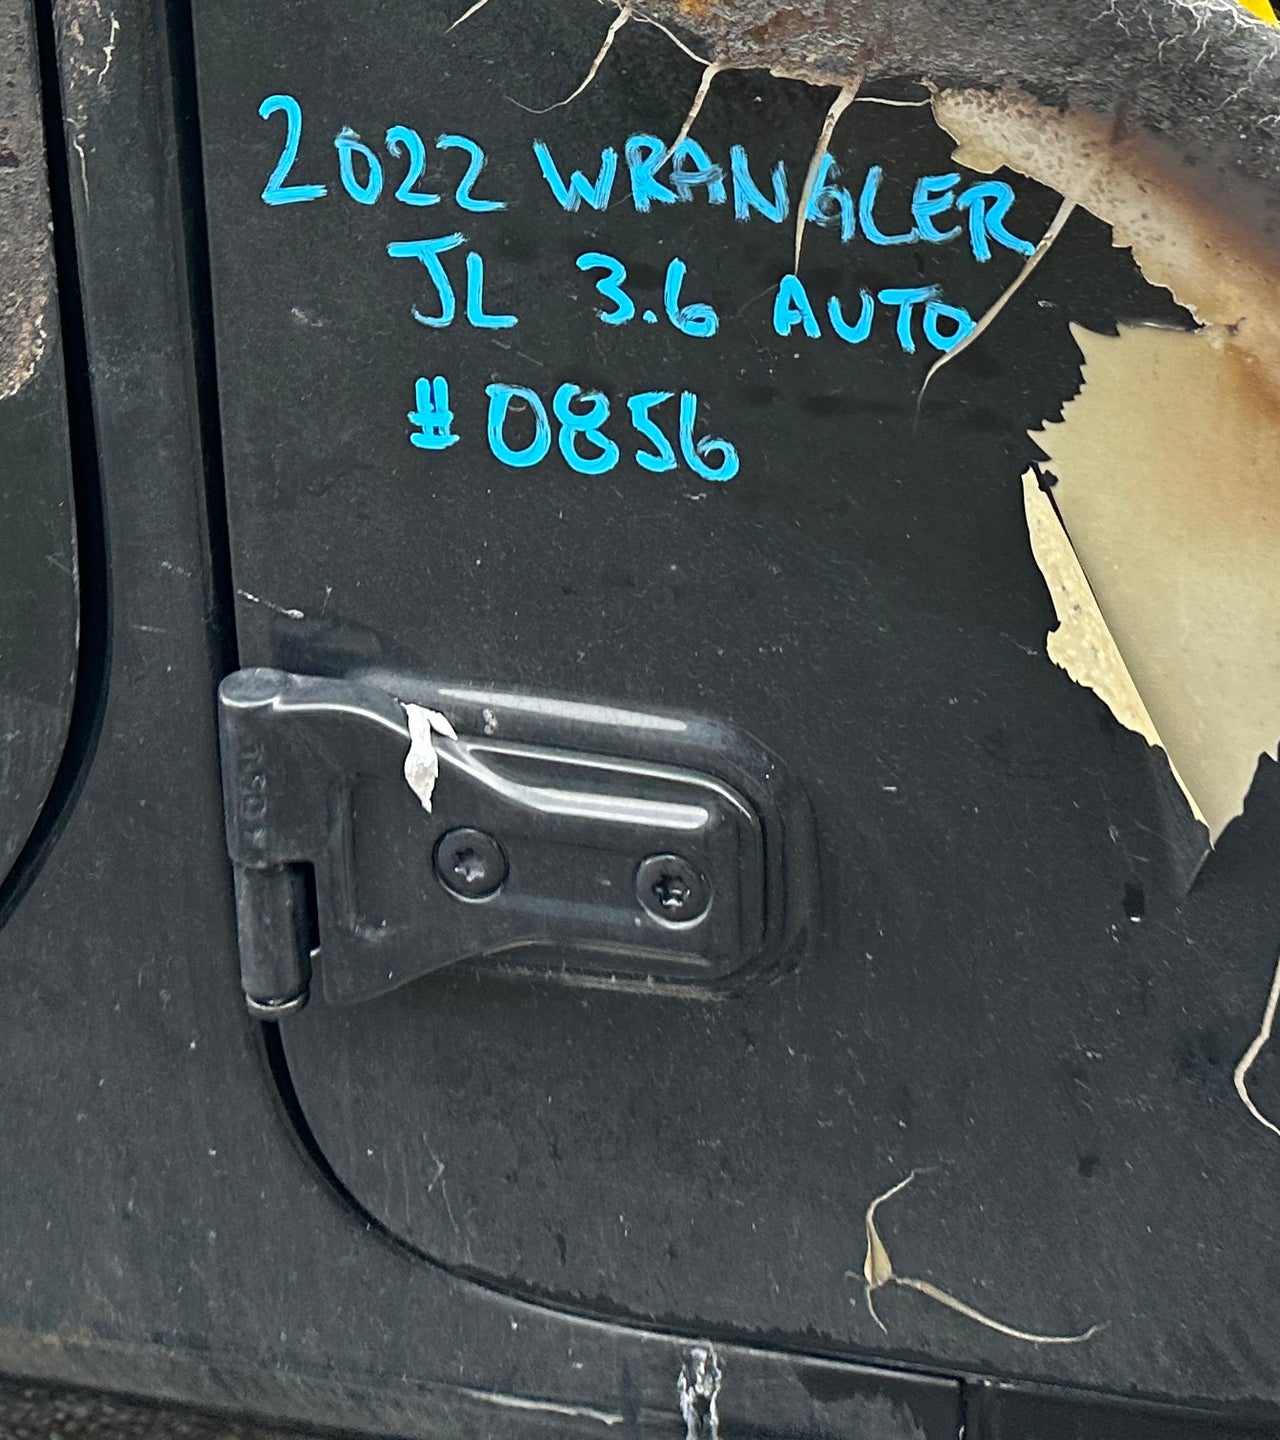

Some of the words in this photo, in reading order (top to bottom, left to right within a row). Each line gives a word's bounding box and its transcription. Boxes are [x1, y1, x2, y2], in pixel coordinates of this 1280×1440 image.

[259, 95, 507, 212] 2022
[534, 134, 1036, 262] WRANGLER
[388, 233, 517, 329] JL
[576, 252, 720, 337] 3.6
[773, 274, 977, 354] AUTO
[408, 376, 740, 482] #0856
